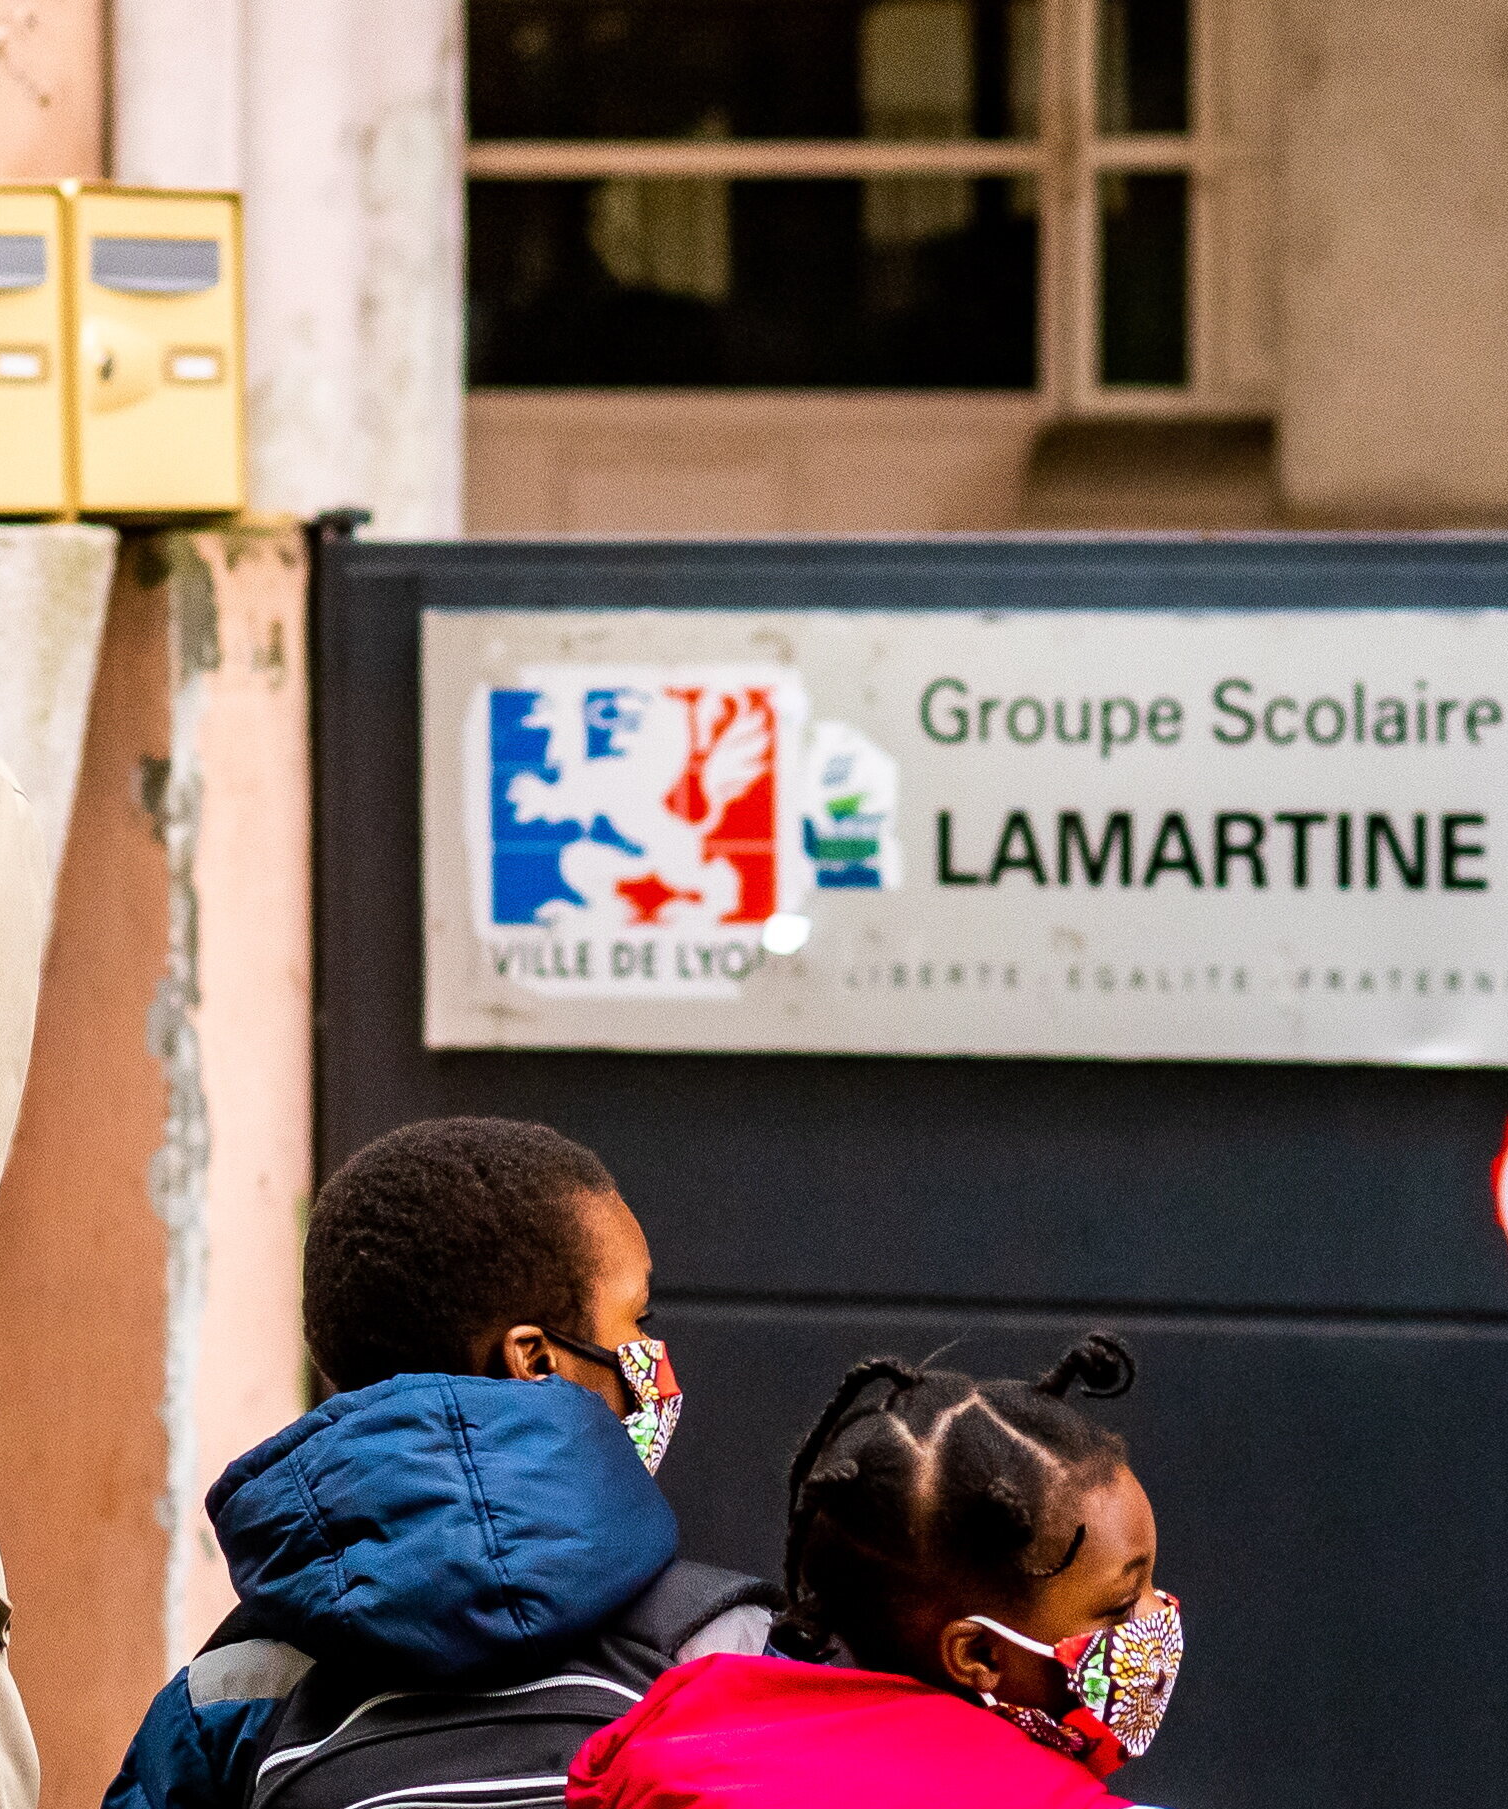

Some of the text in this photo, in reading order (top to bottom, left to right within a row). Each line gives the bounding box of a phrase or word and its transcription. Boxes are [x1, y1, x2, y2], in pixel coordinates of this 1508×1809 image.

[919, 676, 1503, 760] Groupe Scolaire
[935, 808, 1488, 891] LAMARTINE
[493, 940, 591, 980] VILLE
[611, 939, 656, 980] DE
